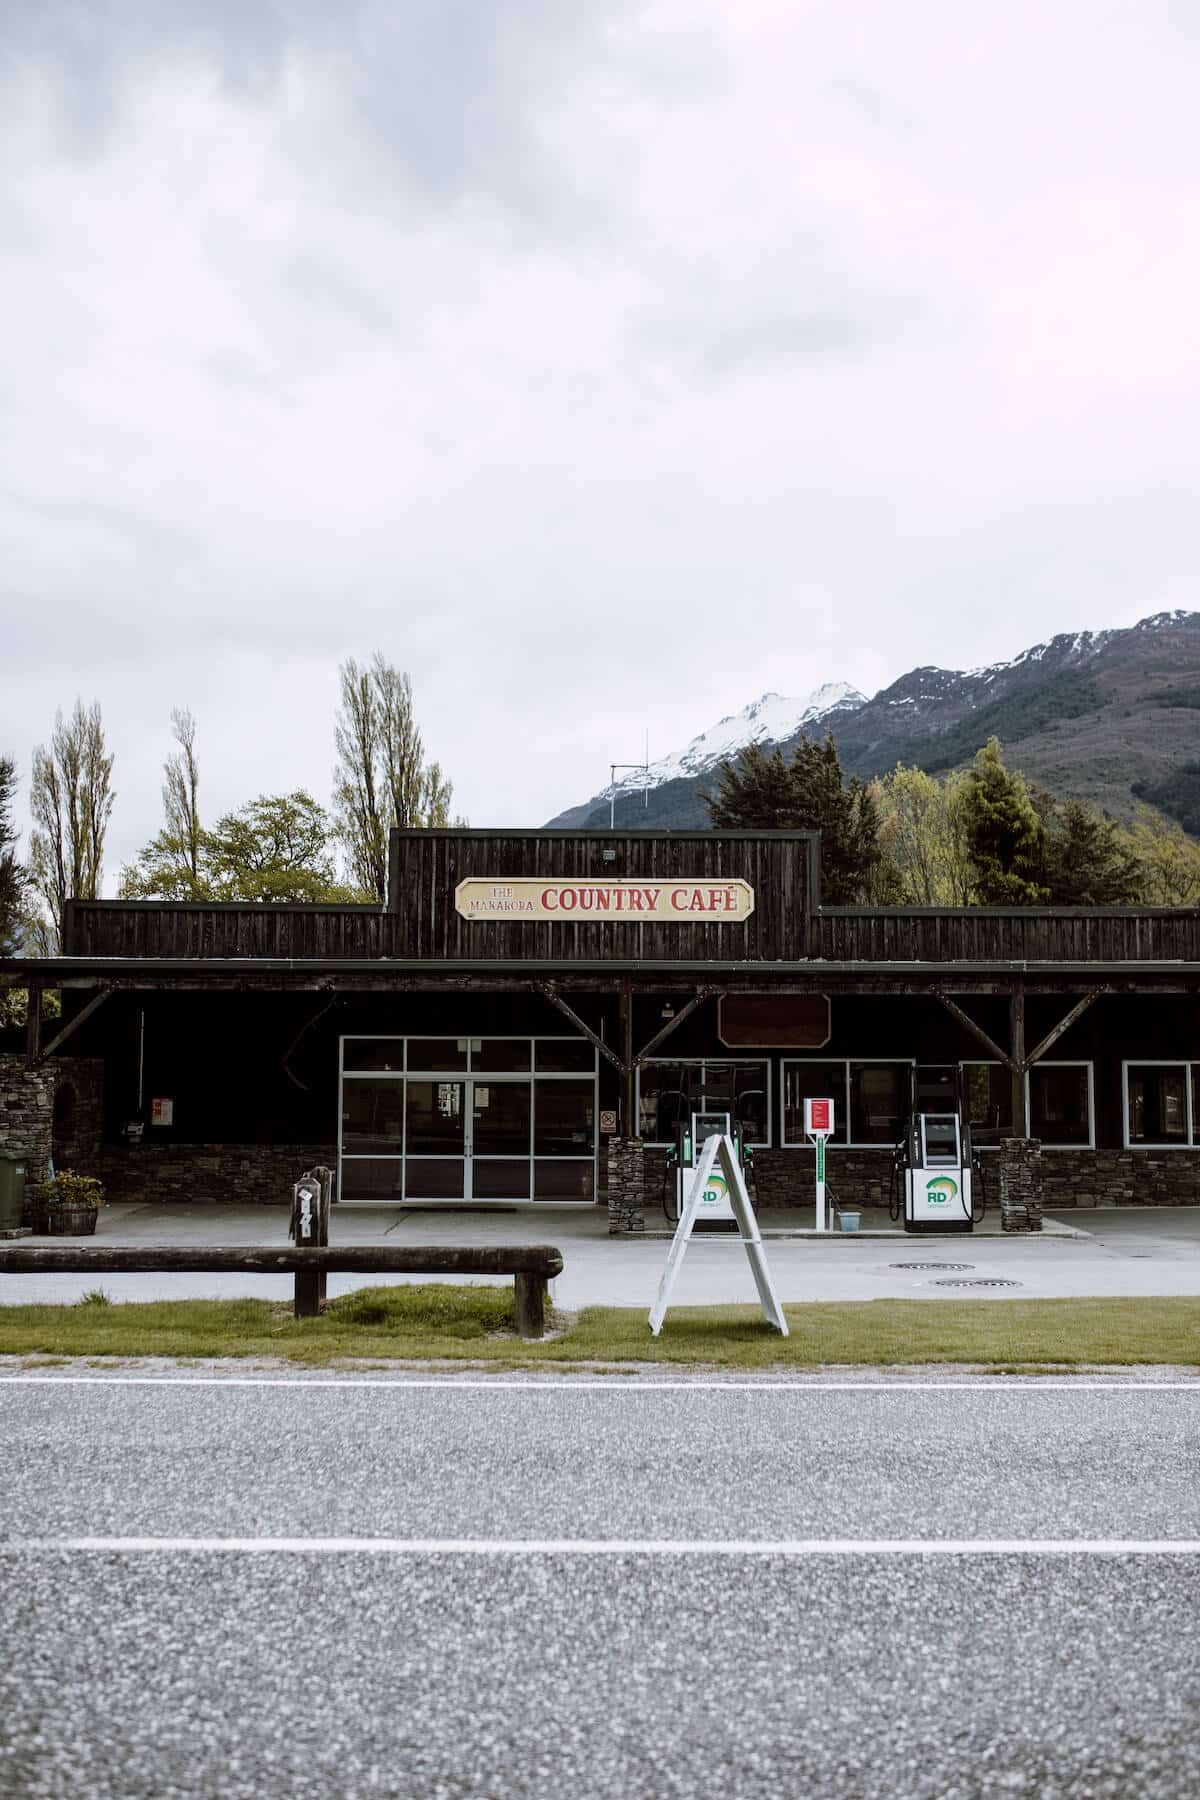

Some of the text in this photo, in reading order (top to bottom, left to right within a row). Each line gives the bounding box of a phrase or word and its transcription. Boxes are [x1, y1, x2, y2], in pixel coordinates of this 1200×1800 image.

[492, 887, 513, 898] THE
[541, 885, 738, 912] COUNTRY CAFÉ
[927, 1192, 947, 1203] RD
